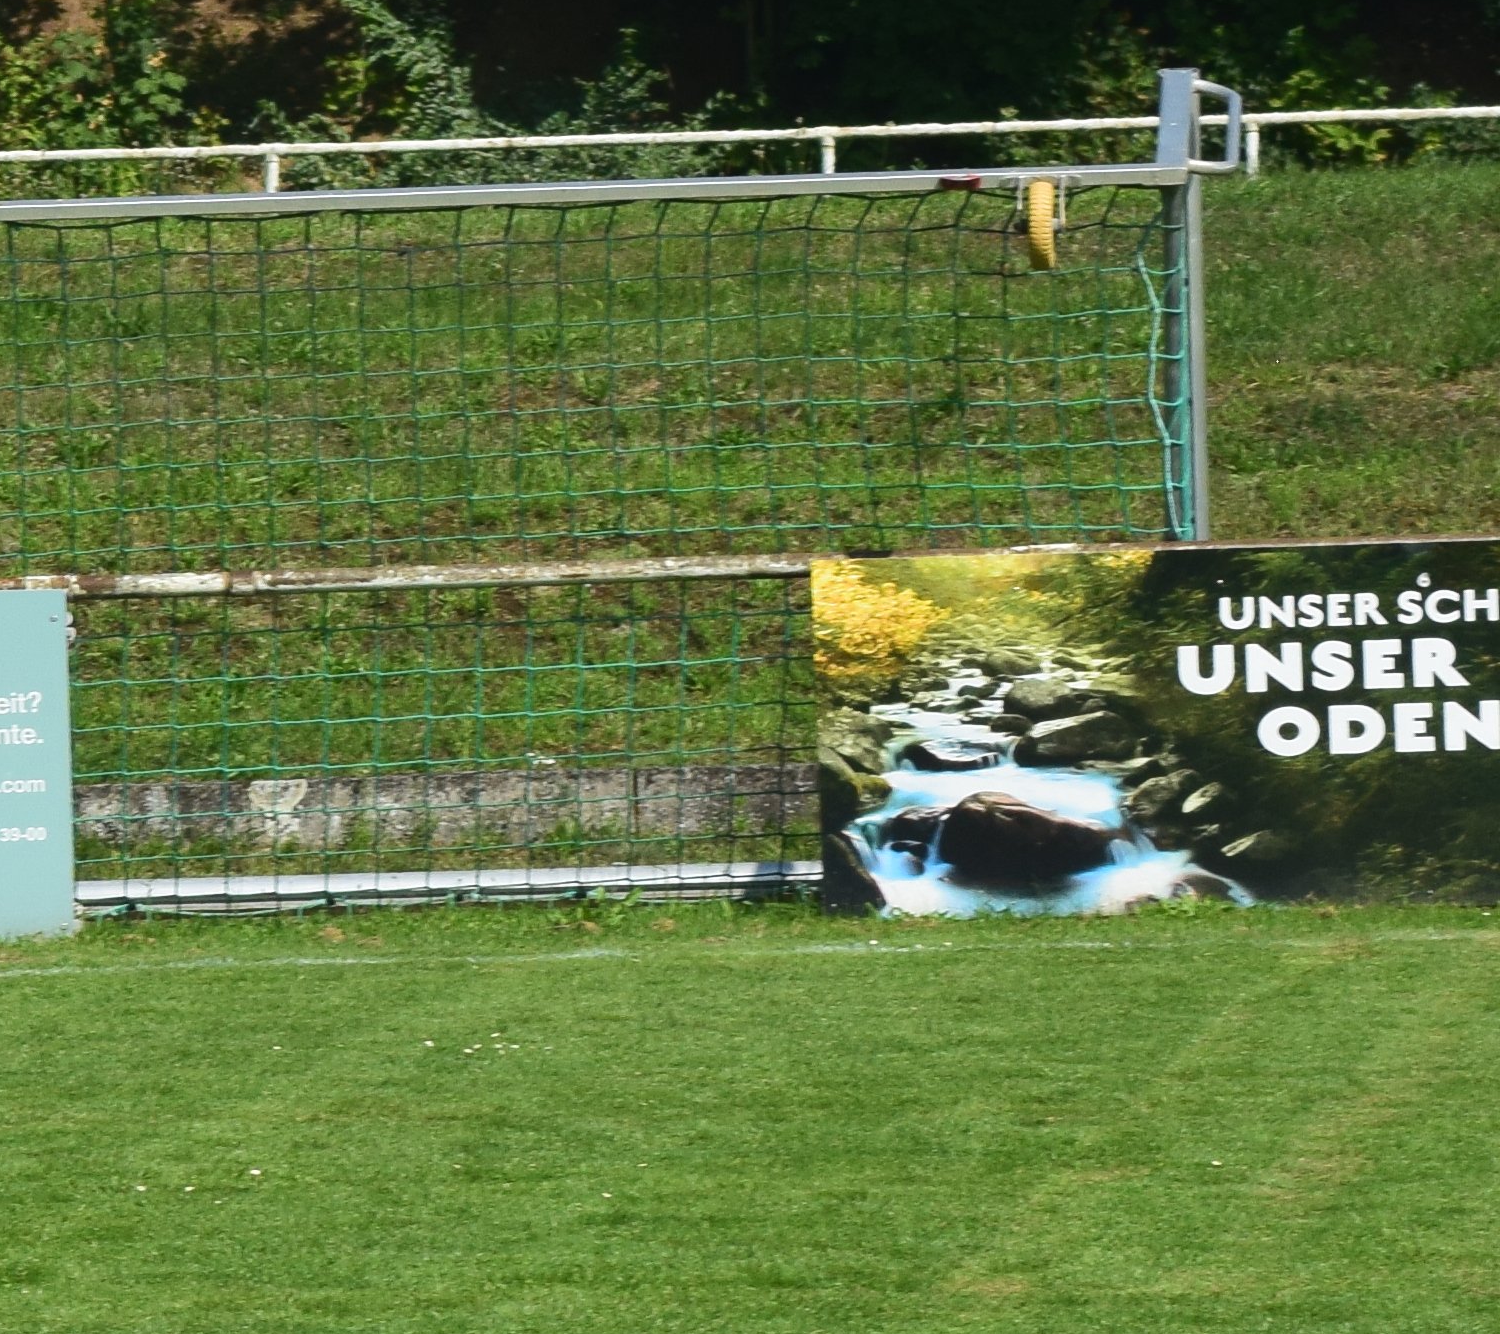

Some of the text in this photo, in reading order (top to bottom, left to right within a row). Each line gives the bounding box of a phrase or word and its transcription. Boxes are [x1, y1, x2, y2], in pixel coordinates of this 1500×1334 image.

[1218, 588, 1500, 630] UNSER SCH
[1177, 638, 1471, 695] UNSER
[1257, 699, 1500, 756] ODEN
